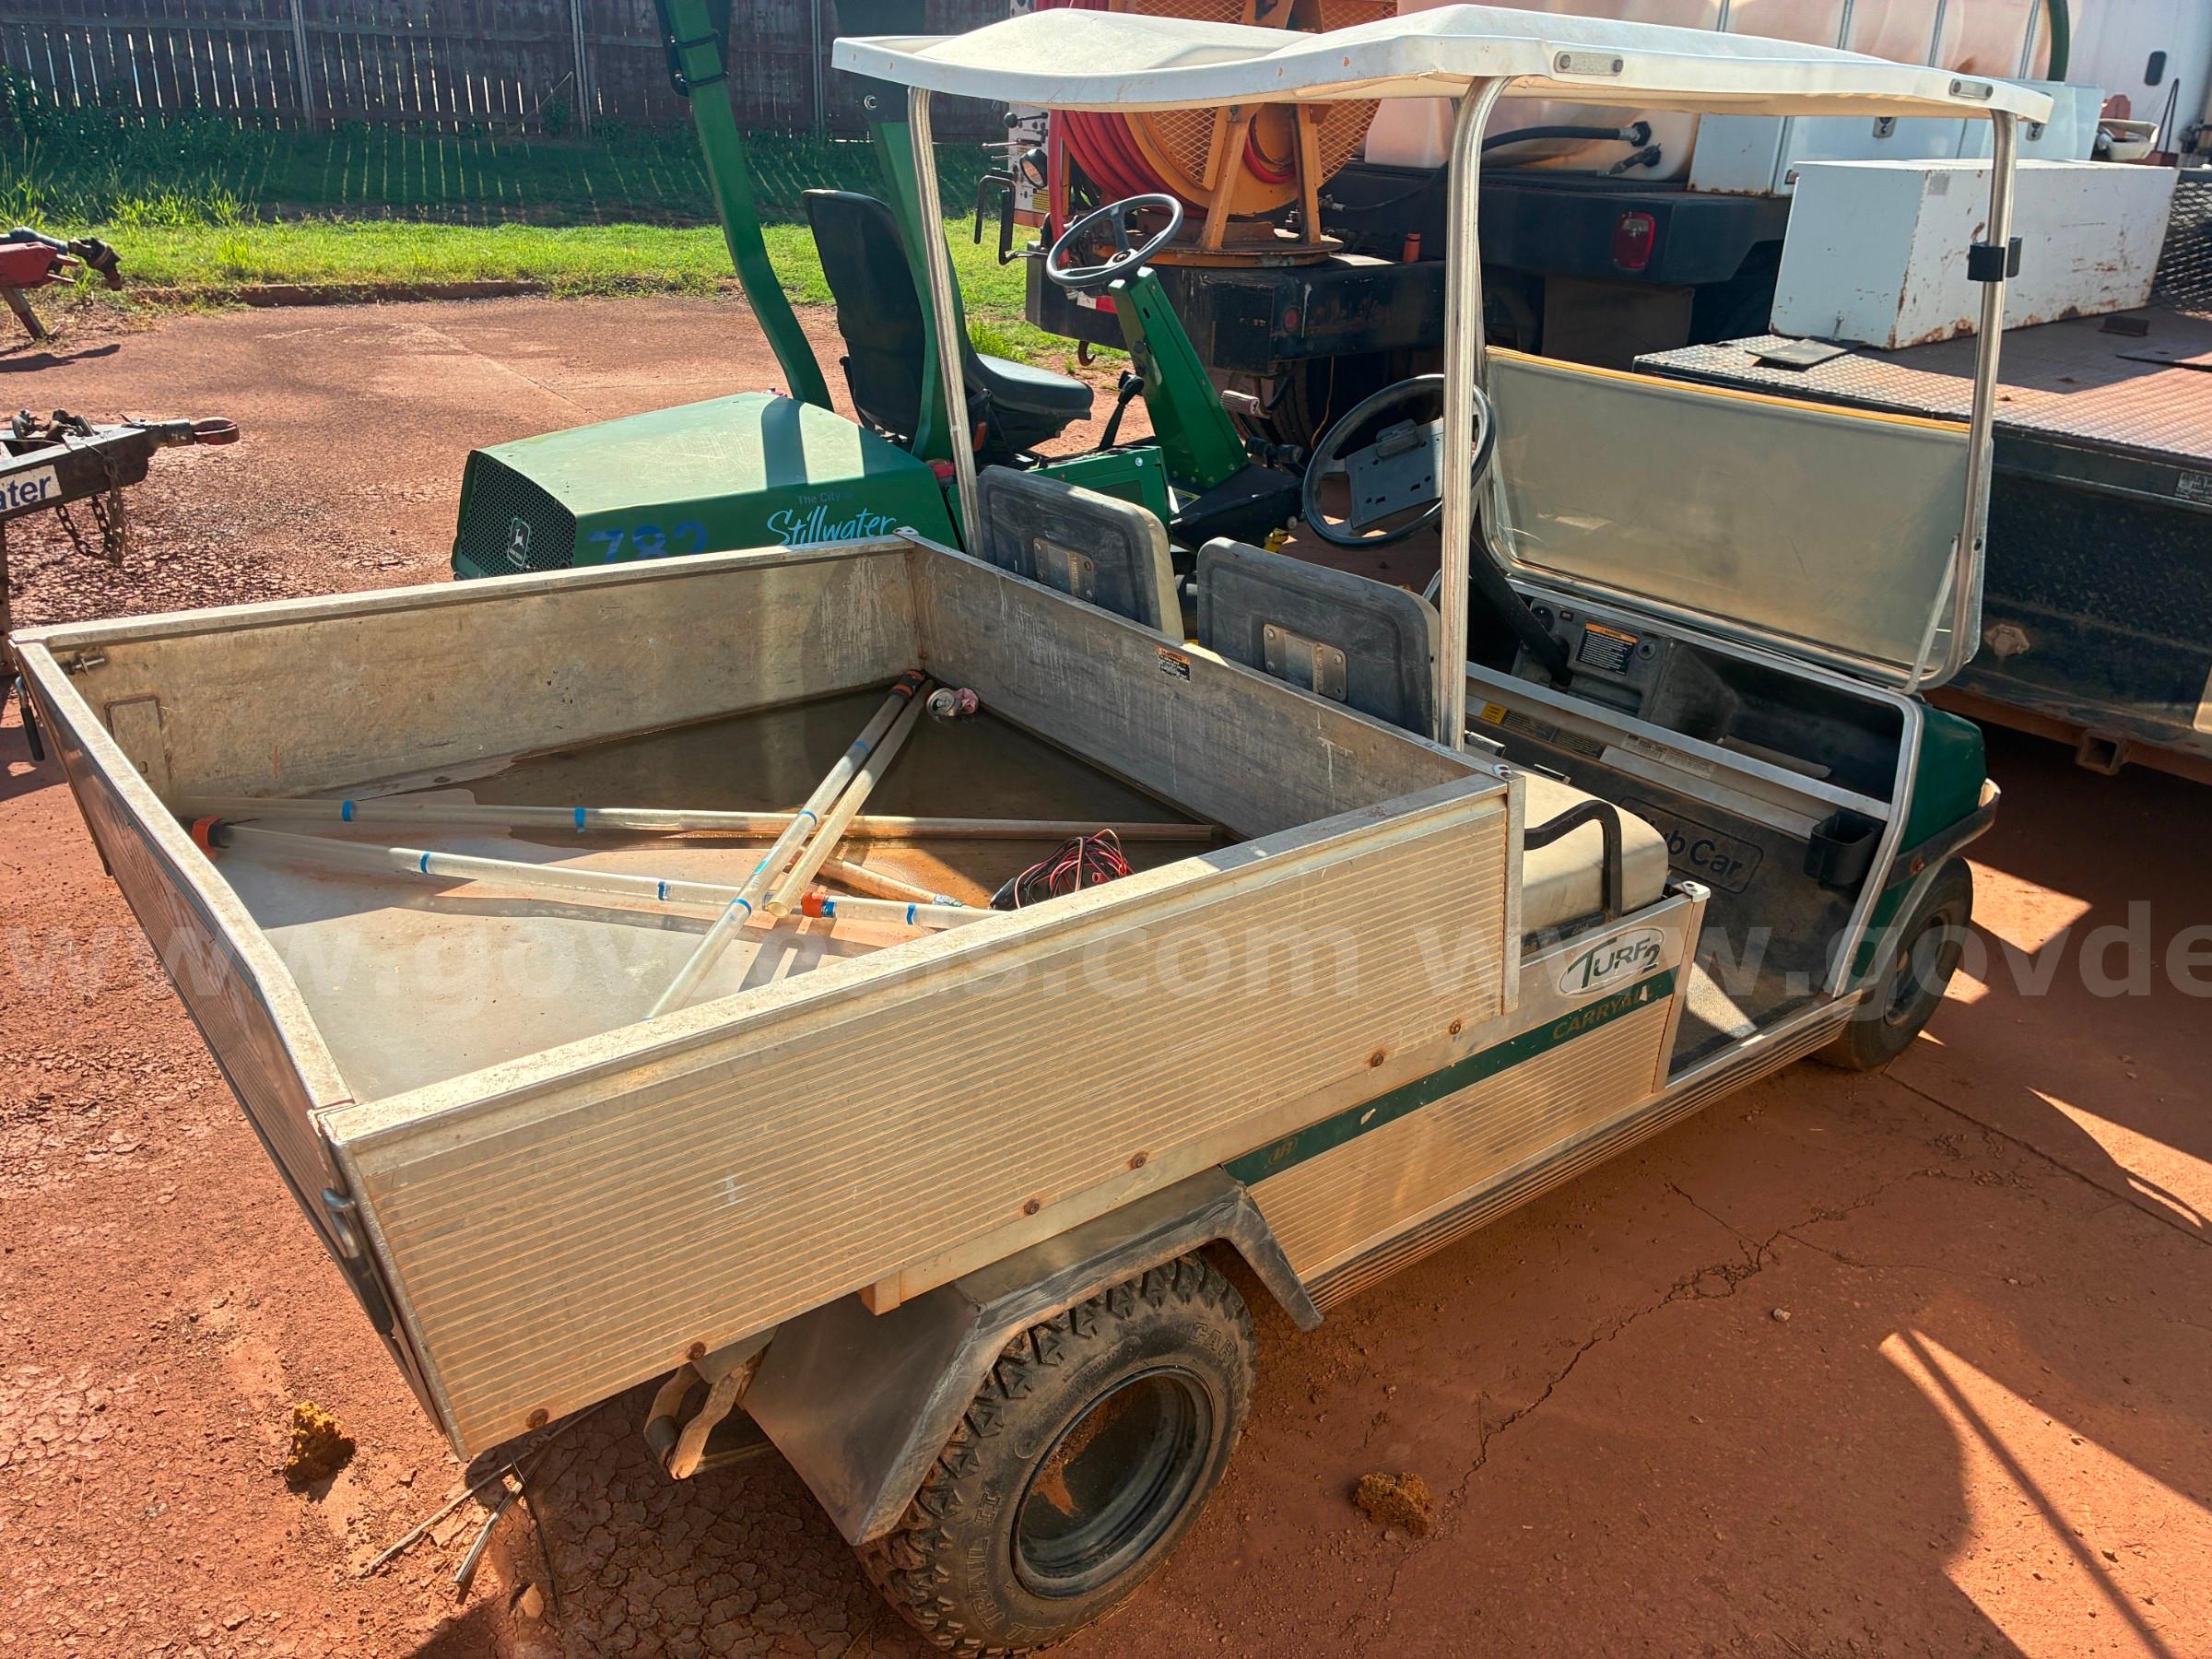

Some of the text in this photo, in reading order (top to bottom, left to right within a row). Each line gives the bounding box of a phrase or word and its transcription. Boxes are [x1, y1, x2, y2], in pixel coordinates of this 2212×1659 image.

[819, 492, 841, 503] City
[767, 504, 897, 547] Stillwater
[1689, 839, 1743, 876] Car
[1567, 936, 1661, 989] TURF 2
[966, 1537, 1006, 1630] TRAIL
